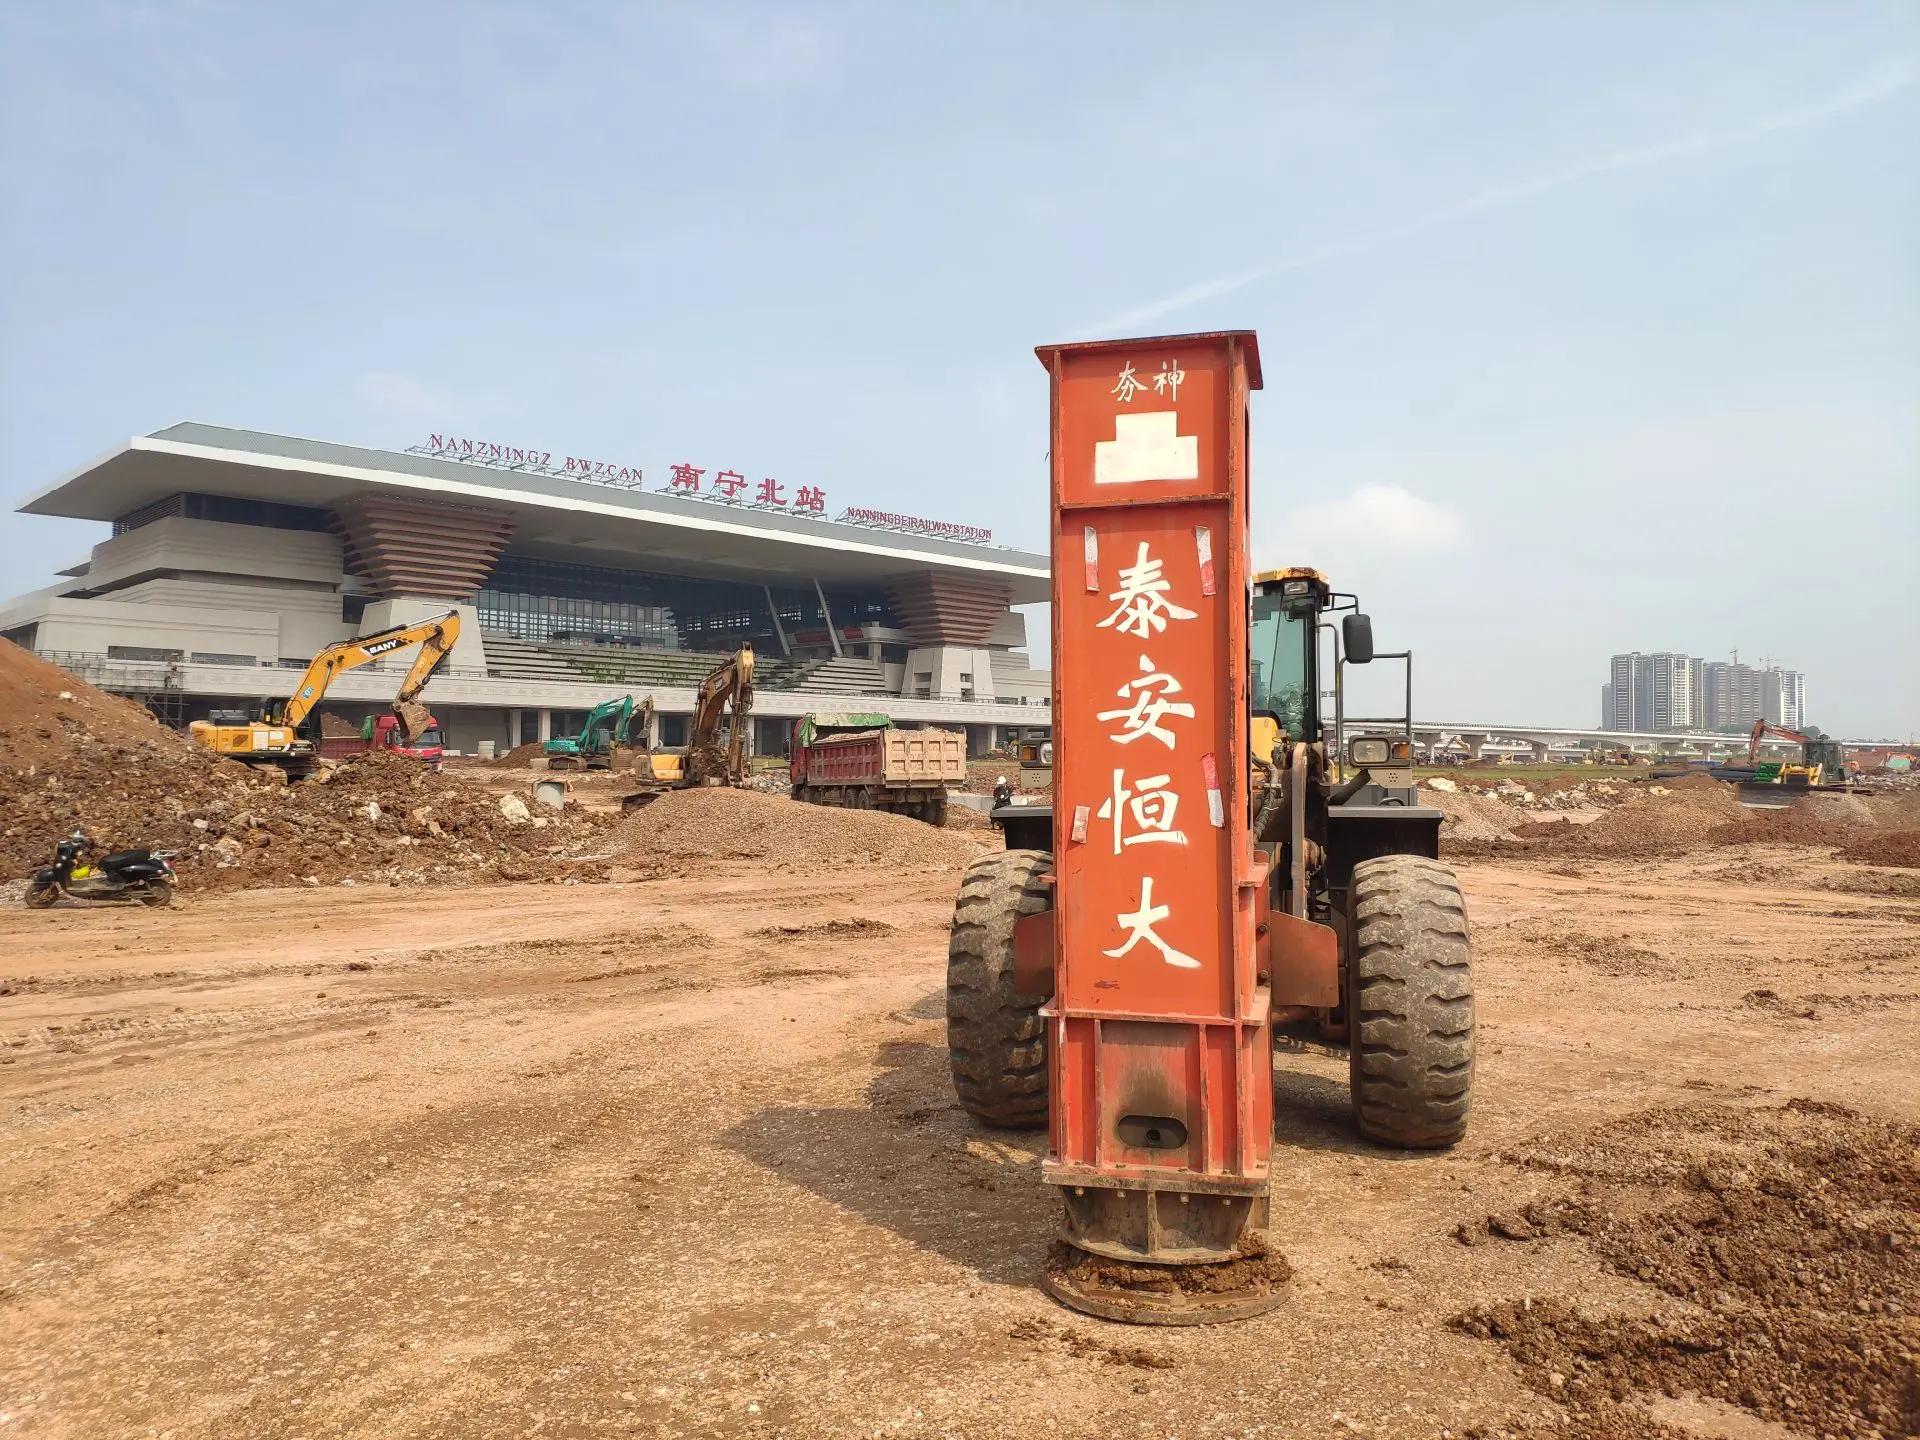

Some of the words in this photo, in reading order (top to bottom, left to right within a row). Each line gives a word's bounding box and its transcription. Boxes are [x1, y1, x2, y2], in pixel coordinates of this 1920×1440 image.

[1111, 360, 1186, 402] 夯神
[431, 434, 551, 466] NANZNINGZ
[566, 457, 642, 481] BWZCAN
[670, 464, 826, 511] 南宁北站
[370, 640, 397, 654] SANY
[1096, 541, 1202, 969] 泰安恒大
